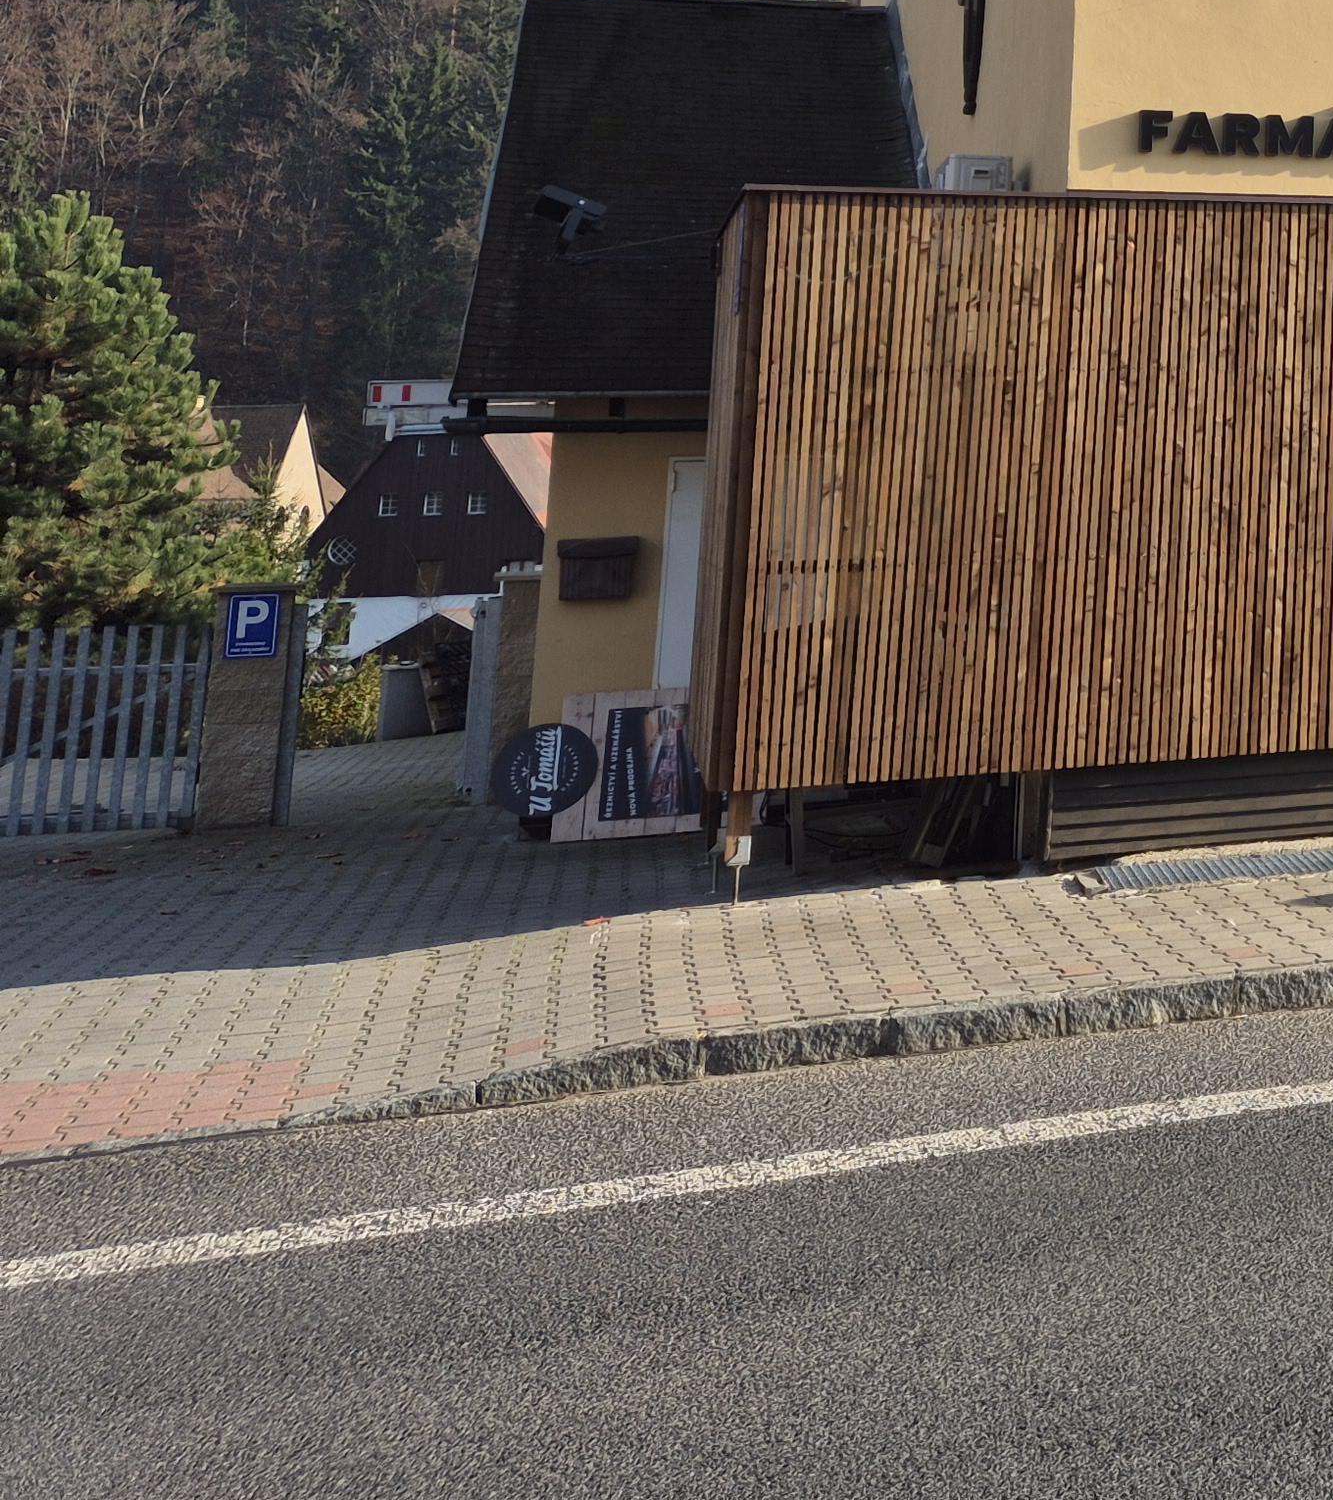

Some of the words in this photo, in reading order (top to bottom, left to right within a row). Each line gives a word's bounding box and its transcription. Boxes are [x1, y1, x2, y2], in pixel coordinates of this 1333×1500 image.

[236, 601, 269, 639] P
[530, 728, 558, 791] Tomášů
[529, 795, 552, 816] U
[604, 773, 617, 818] ŘEZNICTVÍ
